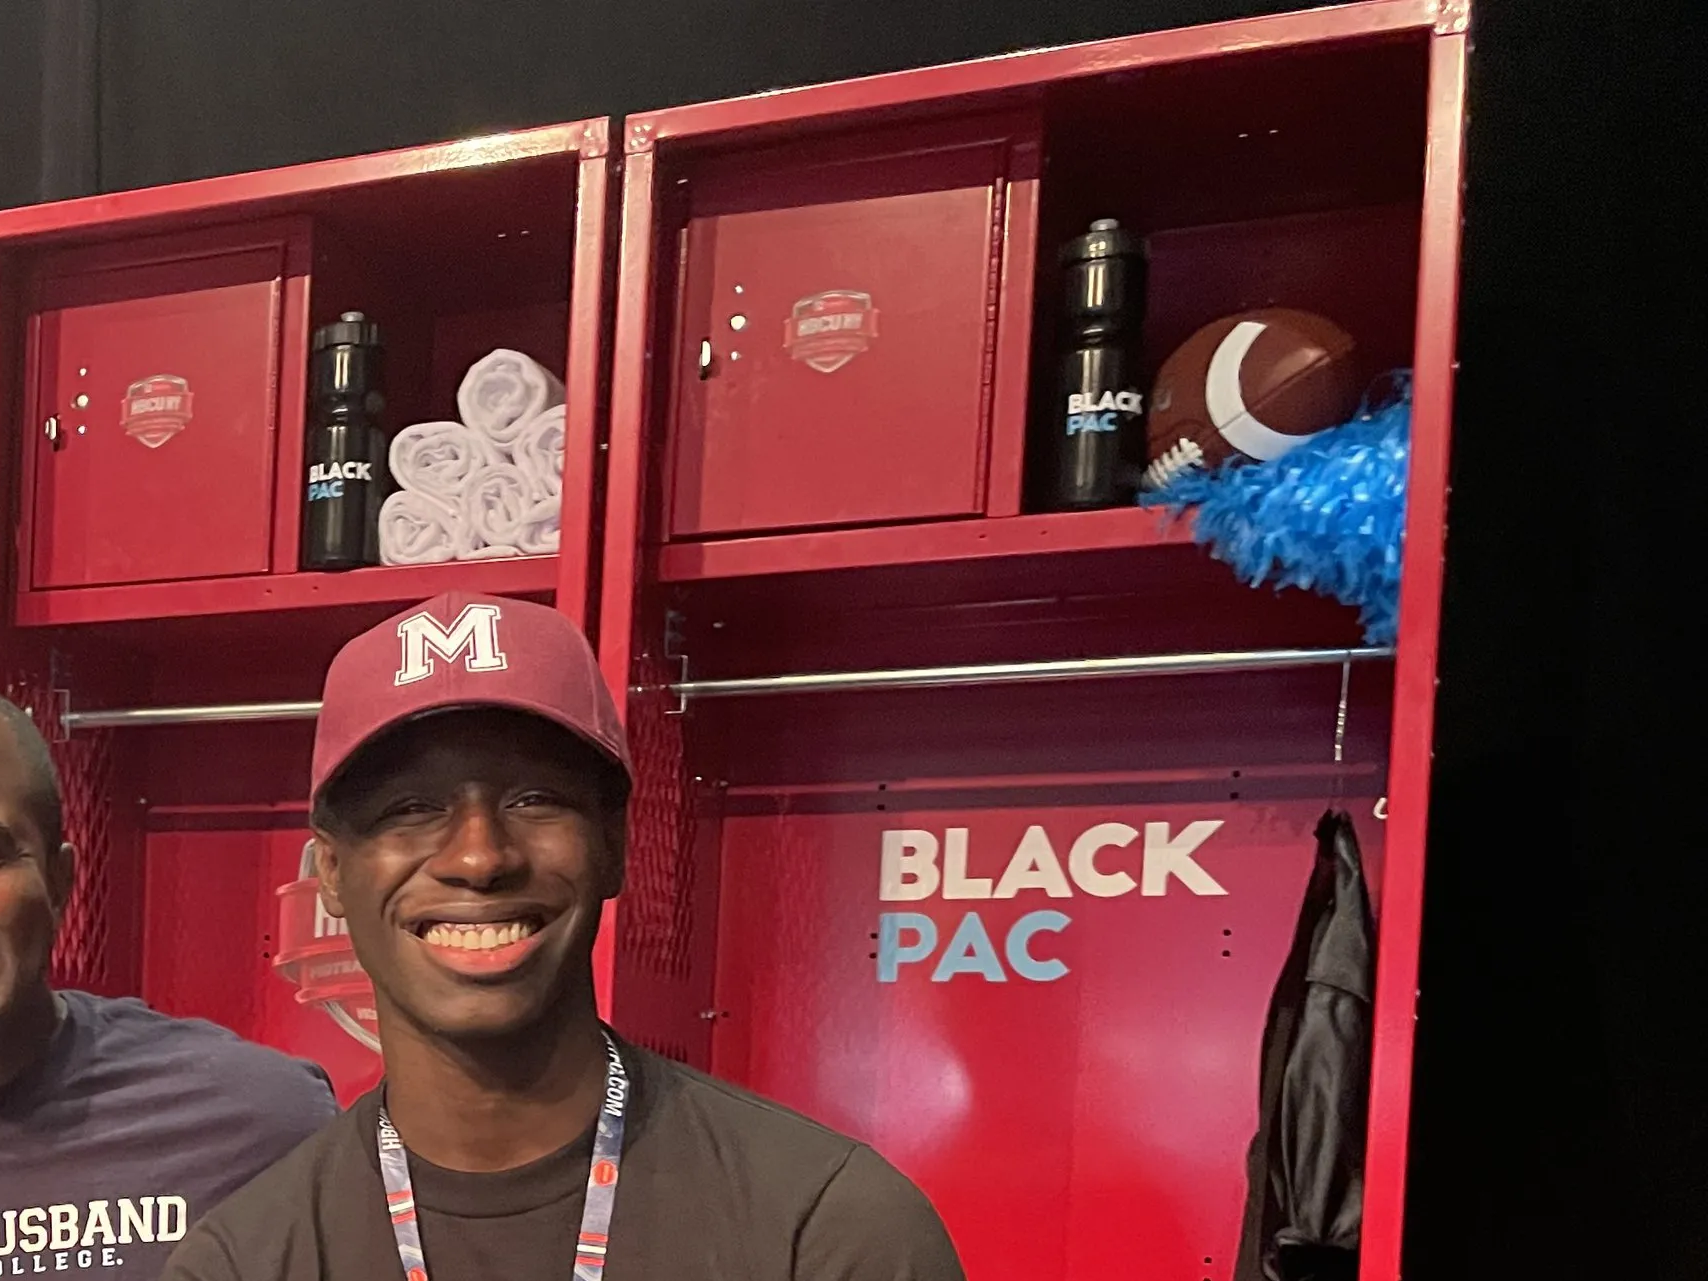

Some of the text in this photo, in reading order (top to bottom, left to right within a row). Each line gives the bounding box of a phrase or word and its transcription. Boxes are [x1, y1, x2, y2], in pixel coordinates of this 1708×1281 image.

[1067, 390, 1143, 415] BLACK
[1066, 412, 1118, 435] PAC
[308, 461, 372, 483] BLACK
[307, 481, 344, 501] PAC
[394, 603, 508, 687] M
[879, 820, 1230, 901] BLACK
[876, 910, 1073, 983] PAC
